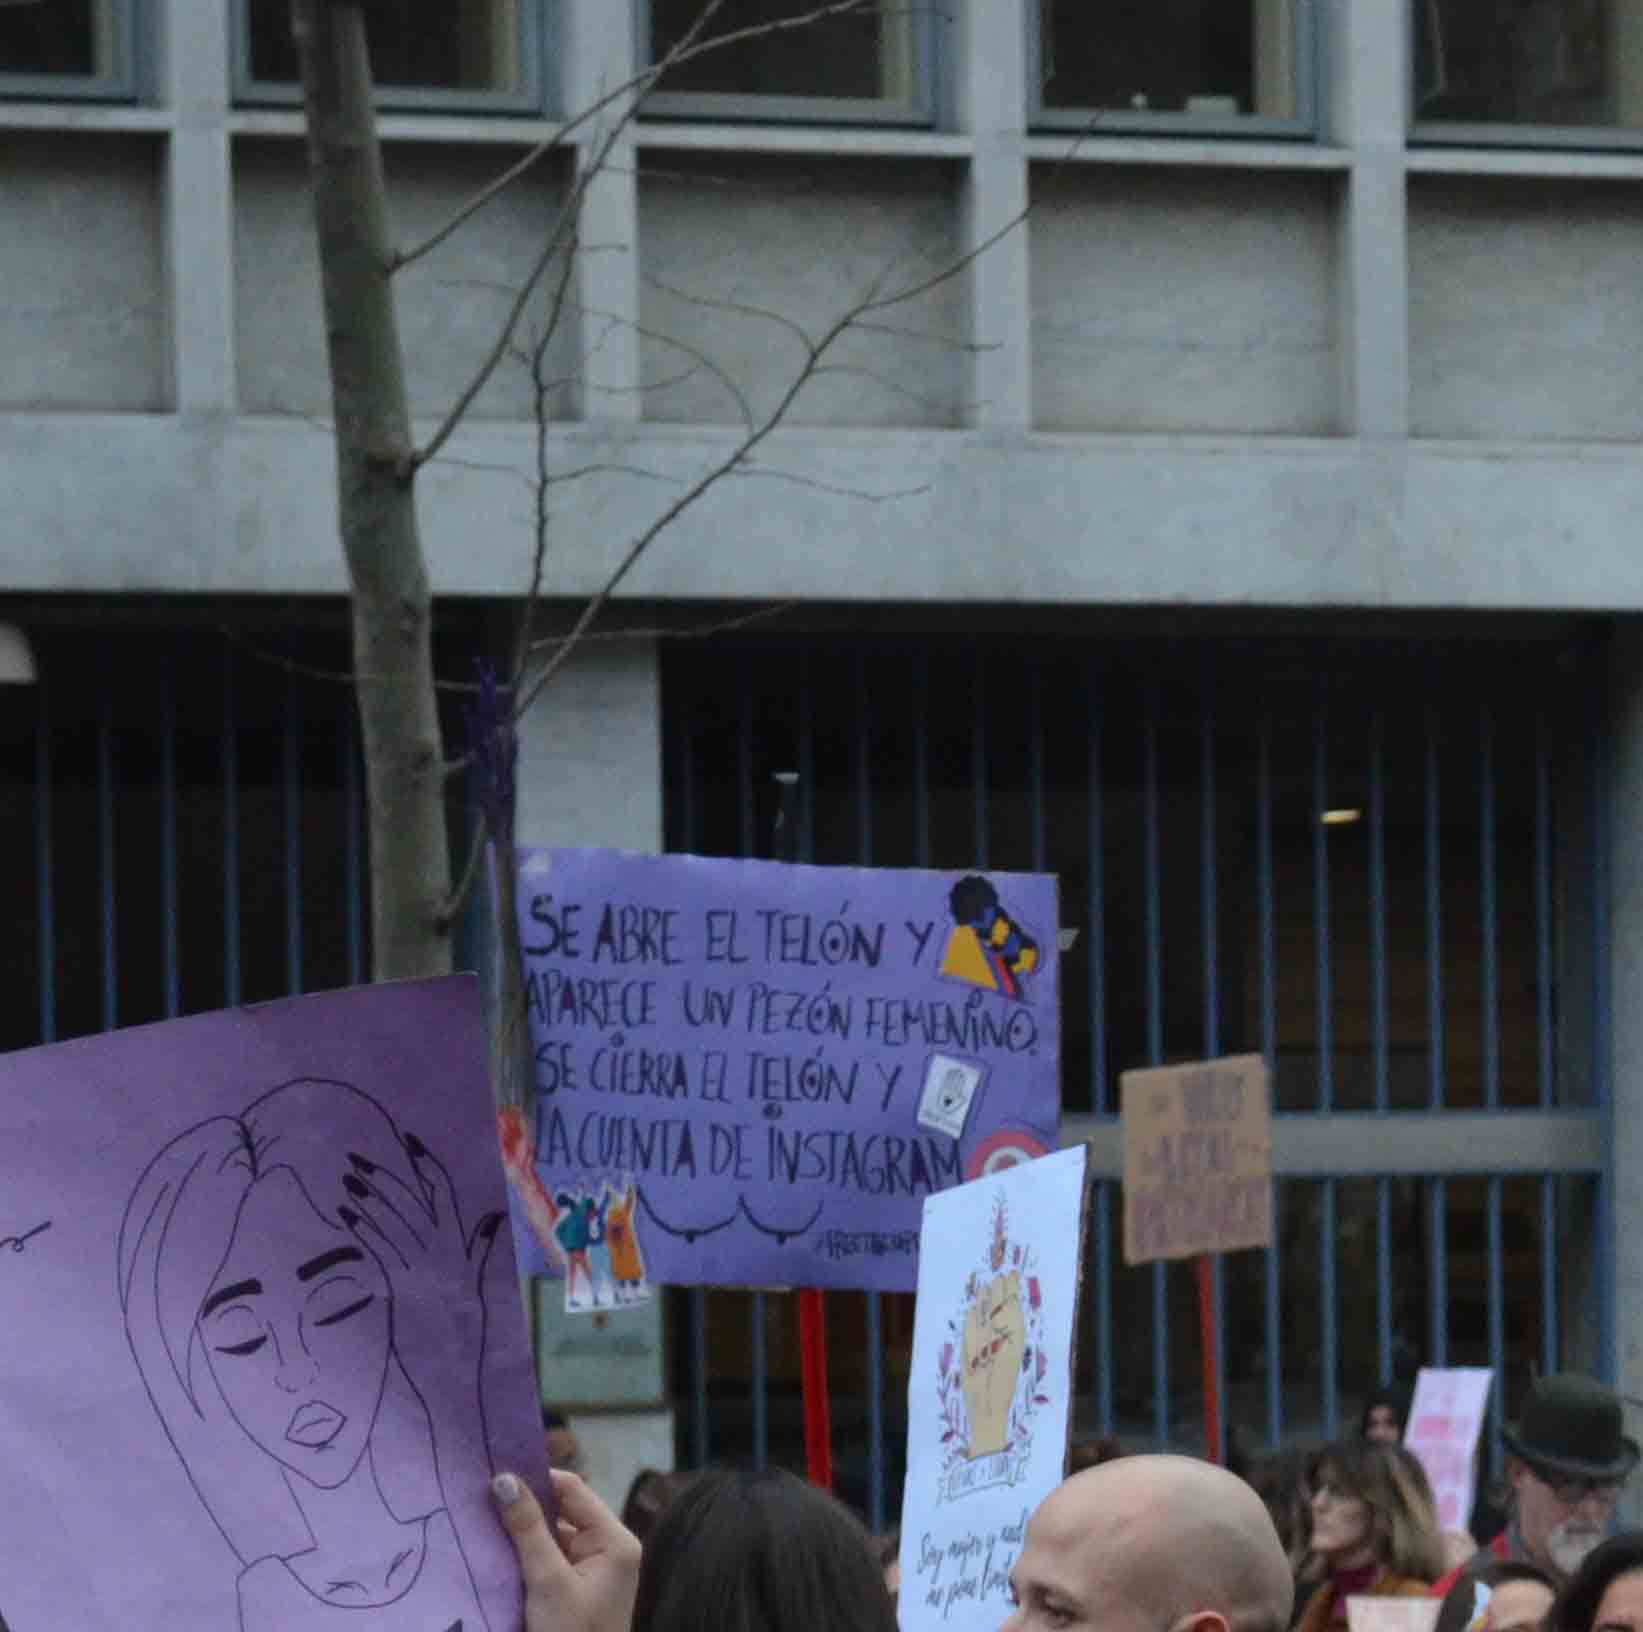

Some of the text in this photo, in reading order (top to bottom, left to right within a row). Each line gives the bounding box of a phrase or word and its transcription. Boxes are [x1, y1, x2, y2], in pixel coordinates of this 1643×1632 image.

[525, 895, 934, 967] SE ABRE EL TELÓN Y
[525, 966, 657, 1029] APARECE
[683, 984, 734, 1029] UN
[746, 982, 851, 1040] PEZÓN
[534, 1041, 575, 1097] SE
[702, 1055, 731, 1102] EL
[746, 1045, 859, 1106] TELÓN
[875, 1063, 902, 1111] Y
[533, 1105, 571, 1168] LA
[578, 1112, 696, 1180] CUENTA
[709, 1124, 752, 1181] DE
